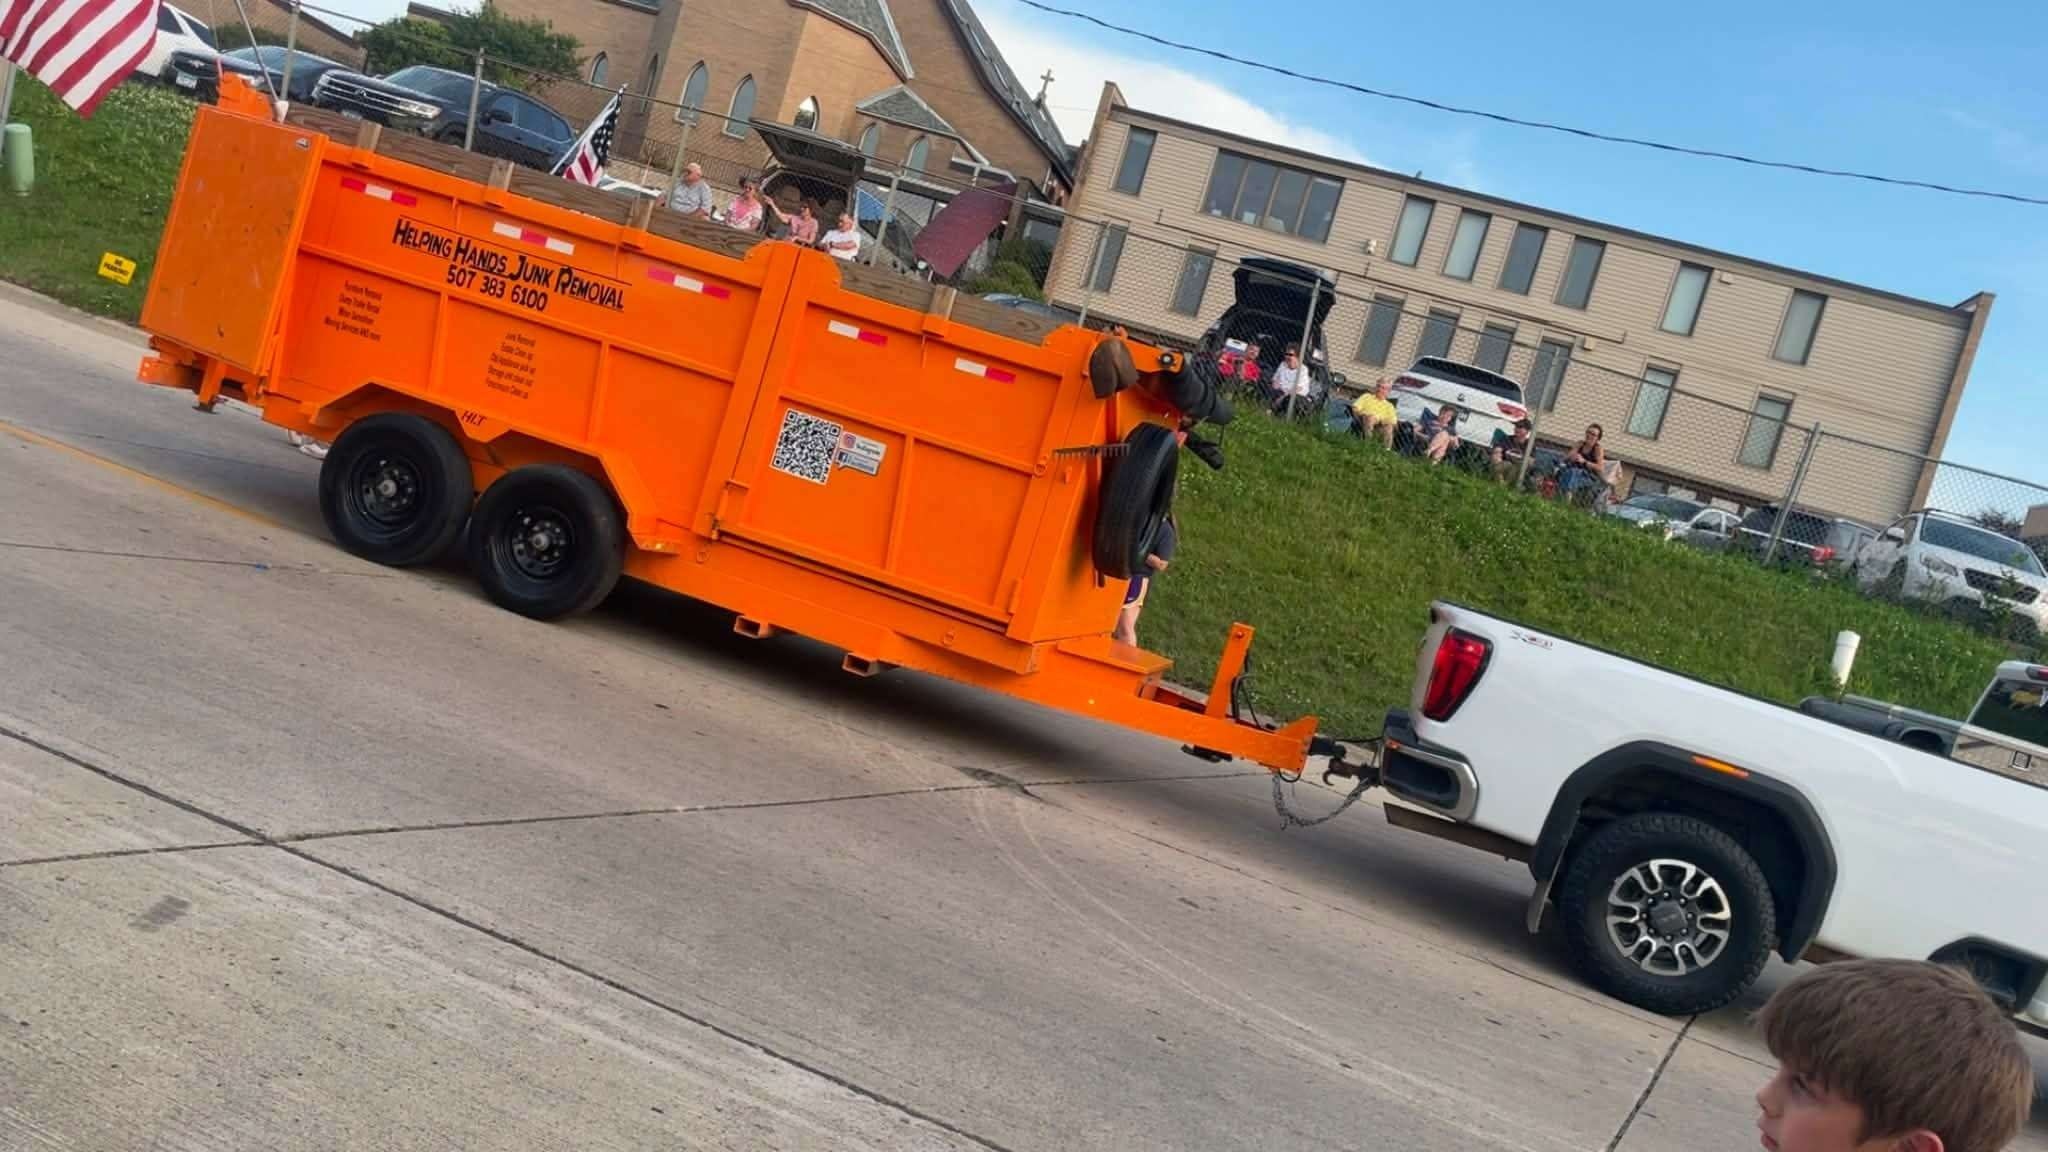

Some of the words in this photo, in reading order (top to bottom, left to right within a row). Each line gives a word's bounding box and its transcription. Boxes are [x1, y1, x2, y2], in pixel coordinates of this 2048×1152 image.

[392, 218, 451, 257] HELPING
[452, 237, 507, 273] HANDS
[508, 255, 555, 288] JUNK
[554, 266, 624, 309] REMOVAL
[447, 264, 476, 289] 507
[480, 275, 505, 298] 383
[511, 284, 548, 312] 6100
